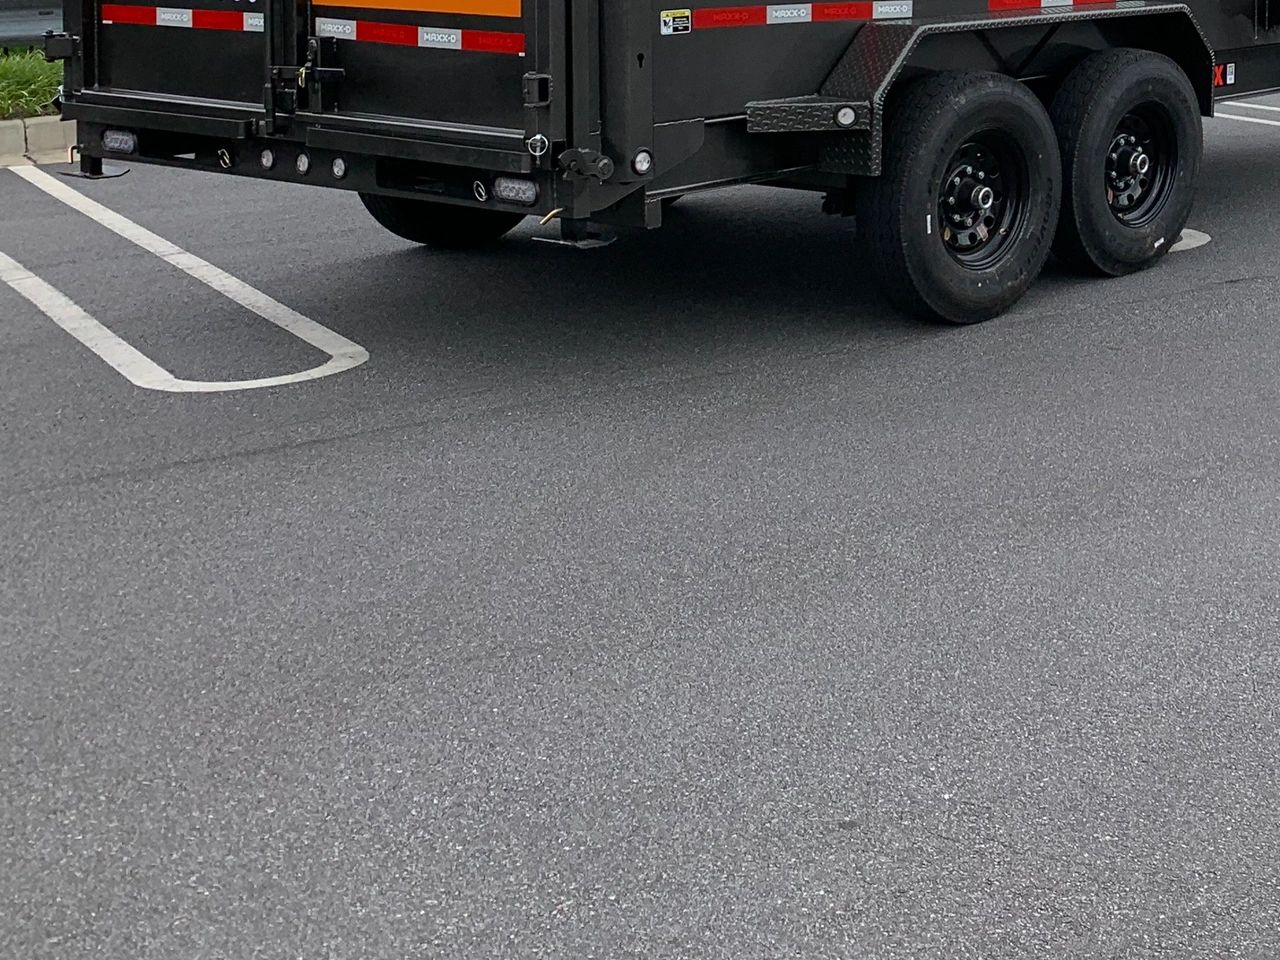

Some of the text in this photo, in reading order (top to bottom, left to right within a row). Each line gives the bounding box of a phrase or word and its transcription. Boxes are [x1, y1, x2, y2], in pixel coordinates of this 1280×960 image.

[772, 8, 807, 18] MAXX-D
[877, 4, 909, 14] MAXX-D
[319, 22, 352, 34] MAXX-D
[423, 32, 457, 44] MAXX-D
